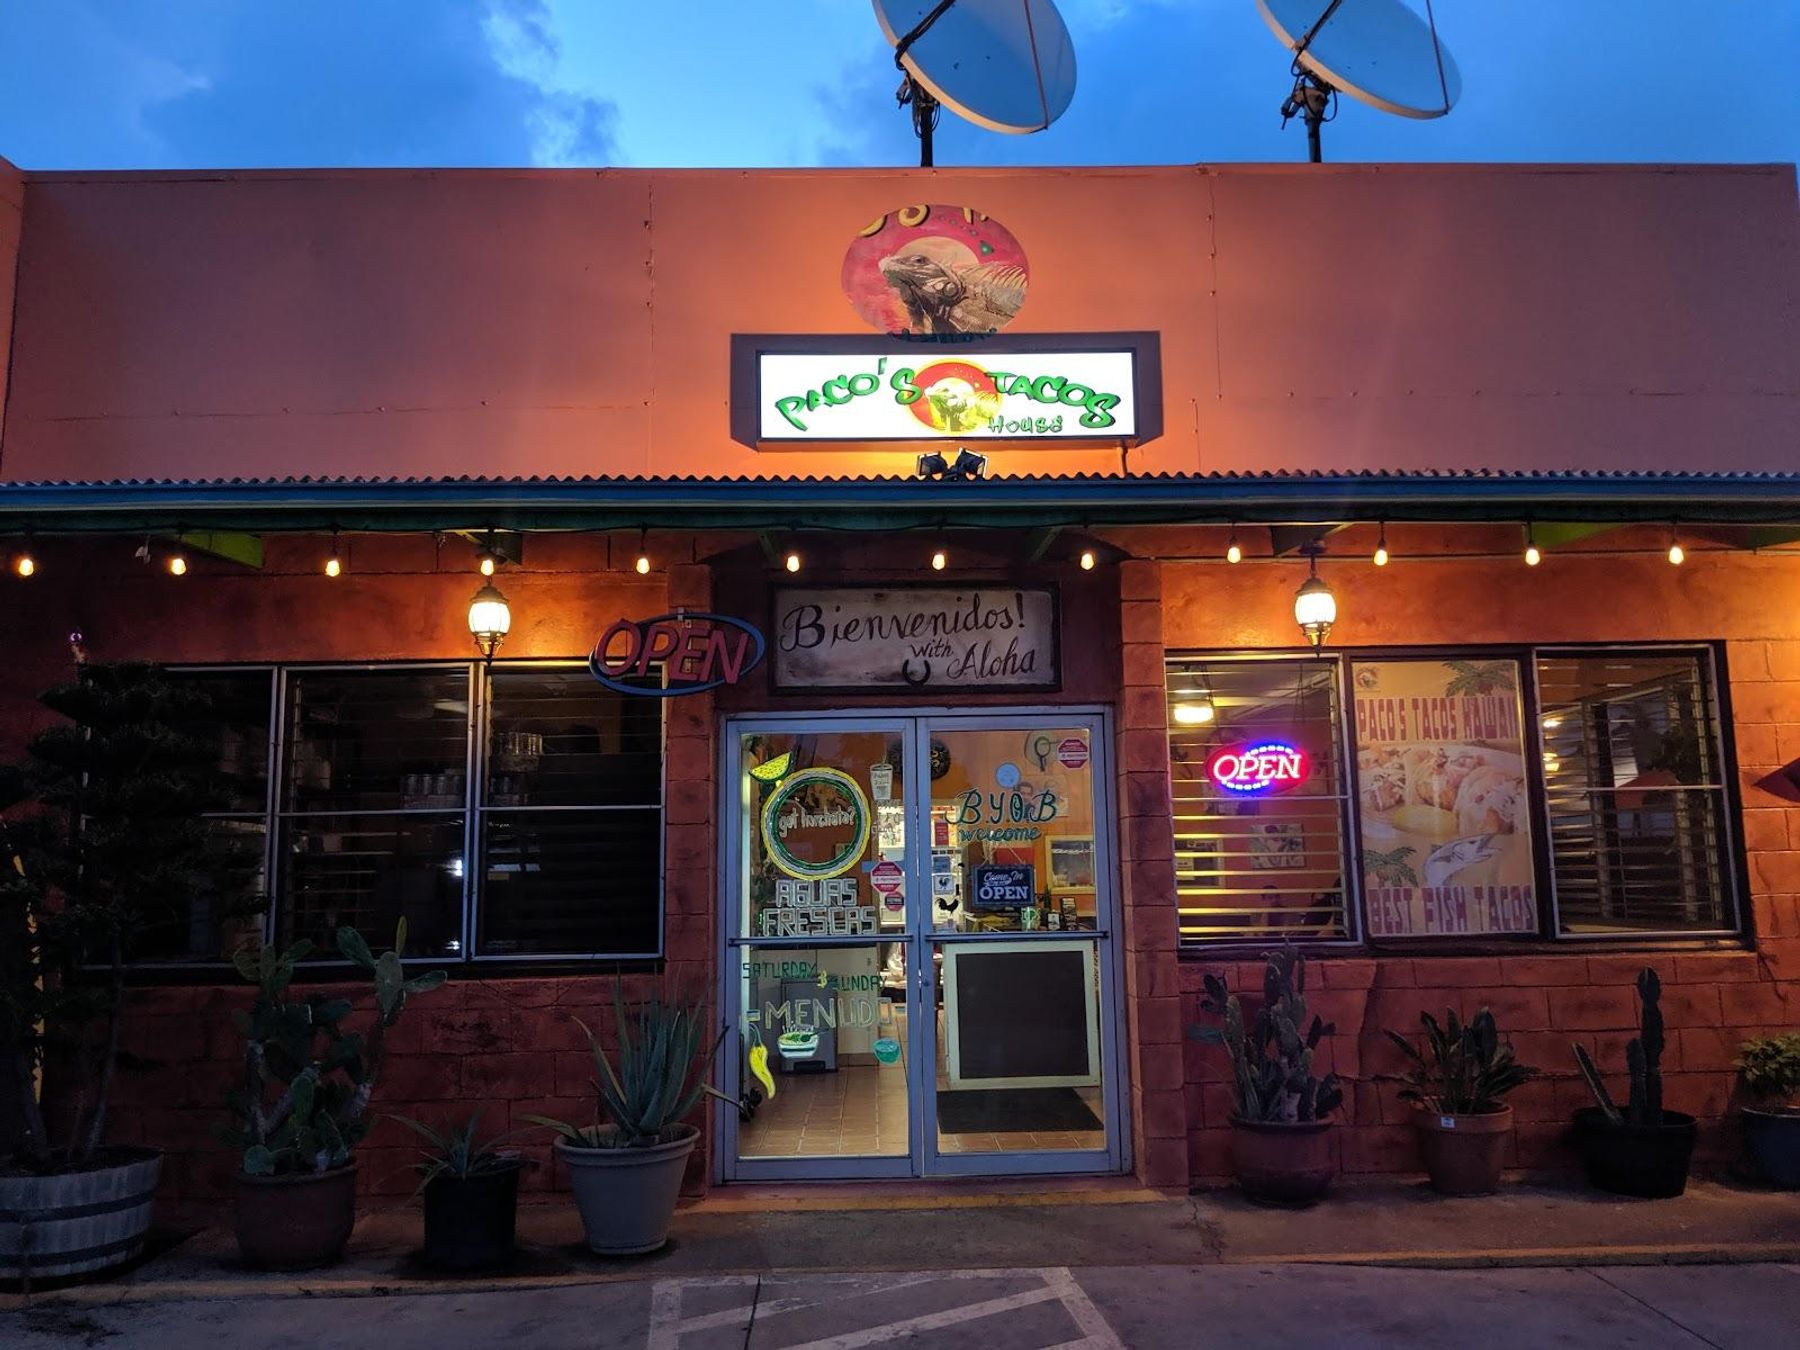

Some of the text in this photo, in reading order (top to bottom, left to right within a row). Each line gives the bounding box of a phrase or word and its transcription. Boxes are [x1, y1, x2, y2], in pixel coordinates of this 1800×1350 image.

[775, 356, 1122, 431] PACO'S TACOS
[778, 592, 1026, 651] Bienvenidos!
[595, 618, 750, 685] OPEN
[910, 636, 1037, 680] with Aloha
[1412, 697, 1457, 740] TACOS
[1213, 753, 1301, 782] OPEN
[778, 807, 799, 838] got
[775, 877, 858, 908] AGUAS
[979, 886, 1030, 900] OPEN
[1367, 885, 1534, 934] BEST FISH TACOS
[763, 905, 878, 937] FRESCAS
[743, 960, 818, 979] SATURDAY
[831, 975, 888, 992] SUNDAY
[764, 996, 893, 1030] MENUDO
